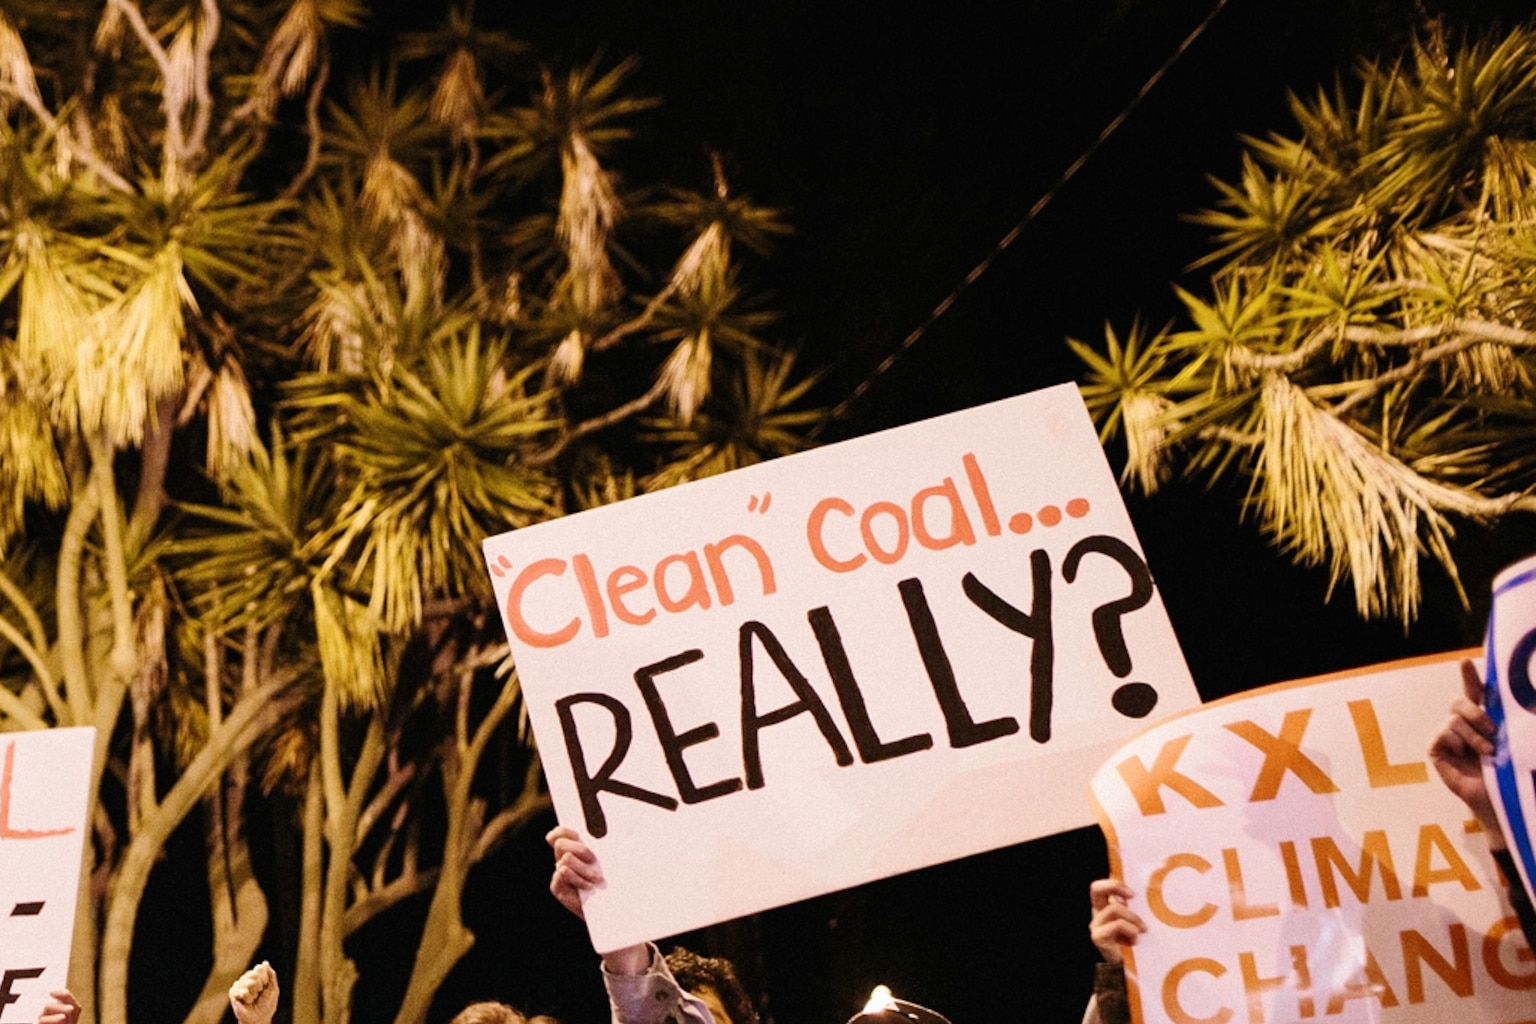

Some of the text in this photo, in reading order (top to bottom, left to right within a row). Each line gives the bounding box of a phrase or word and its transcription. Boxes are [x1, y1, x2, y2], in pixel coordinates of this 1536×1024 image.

[555, 535, 1159, 839] REALLY?
[1115, 698, 1429, 817] KXL
[1146, 818, 1487, 929] CLIMA
